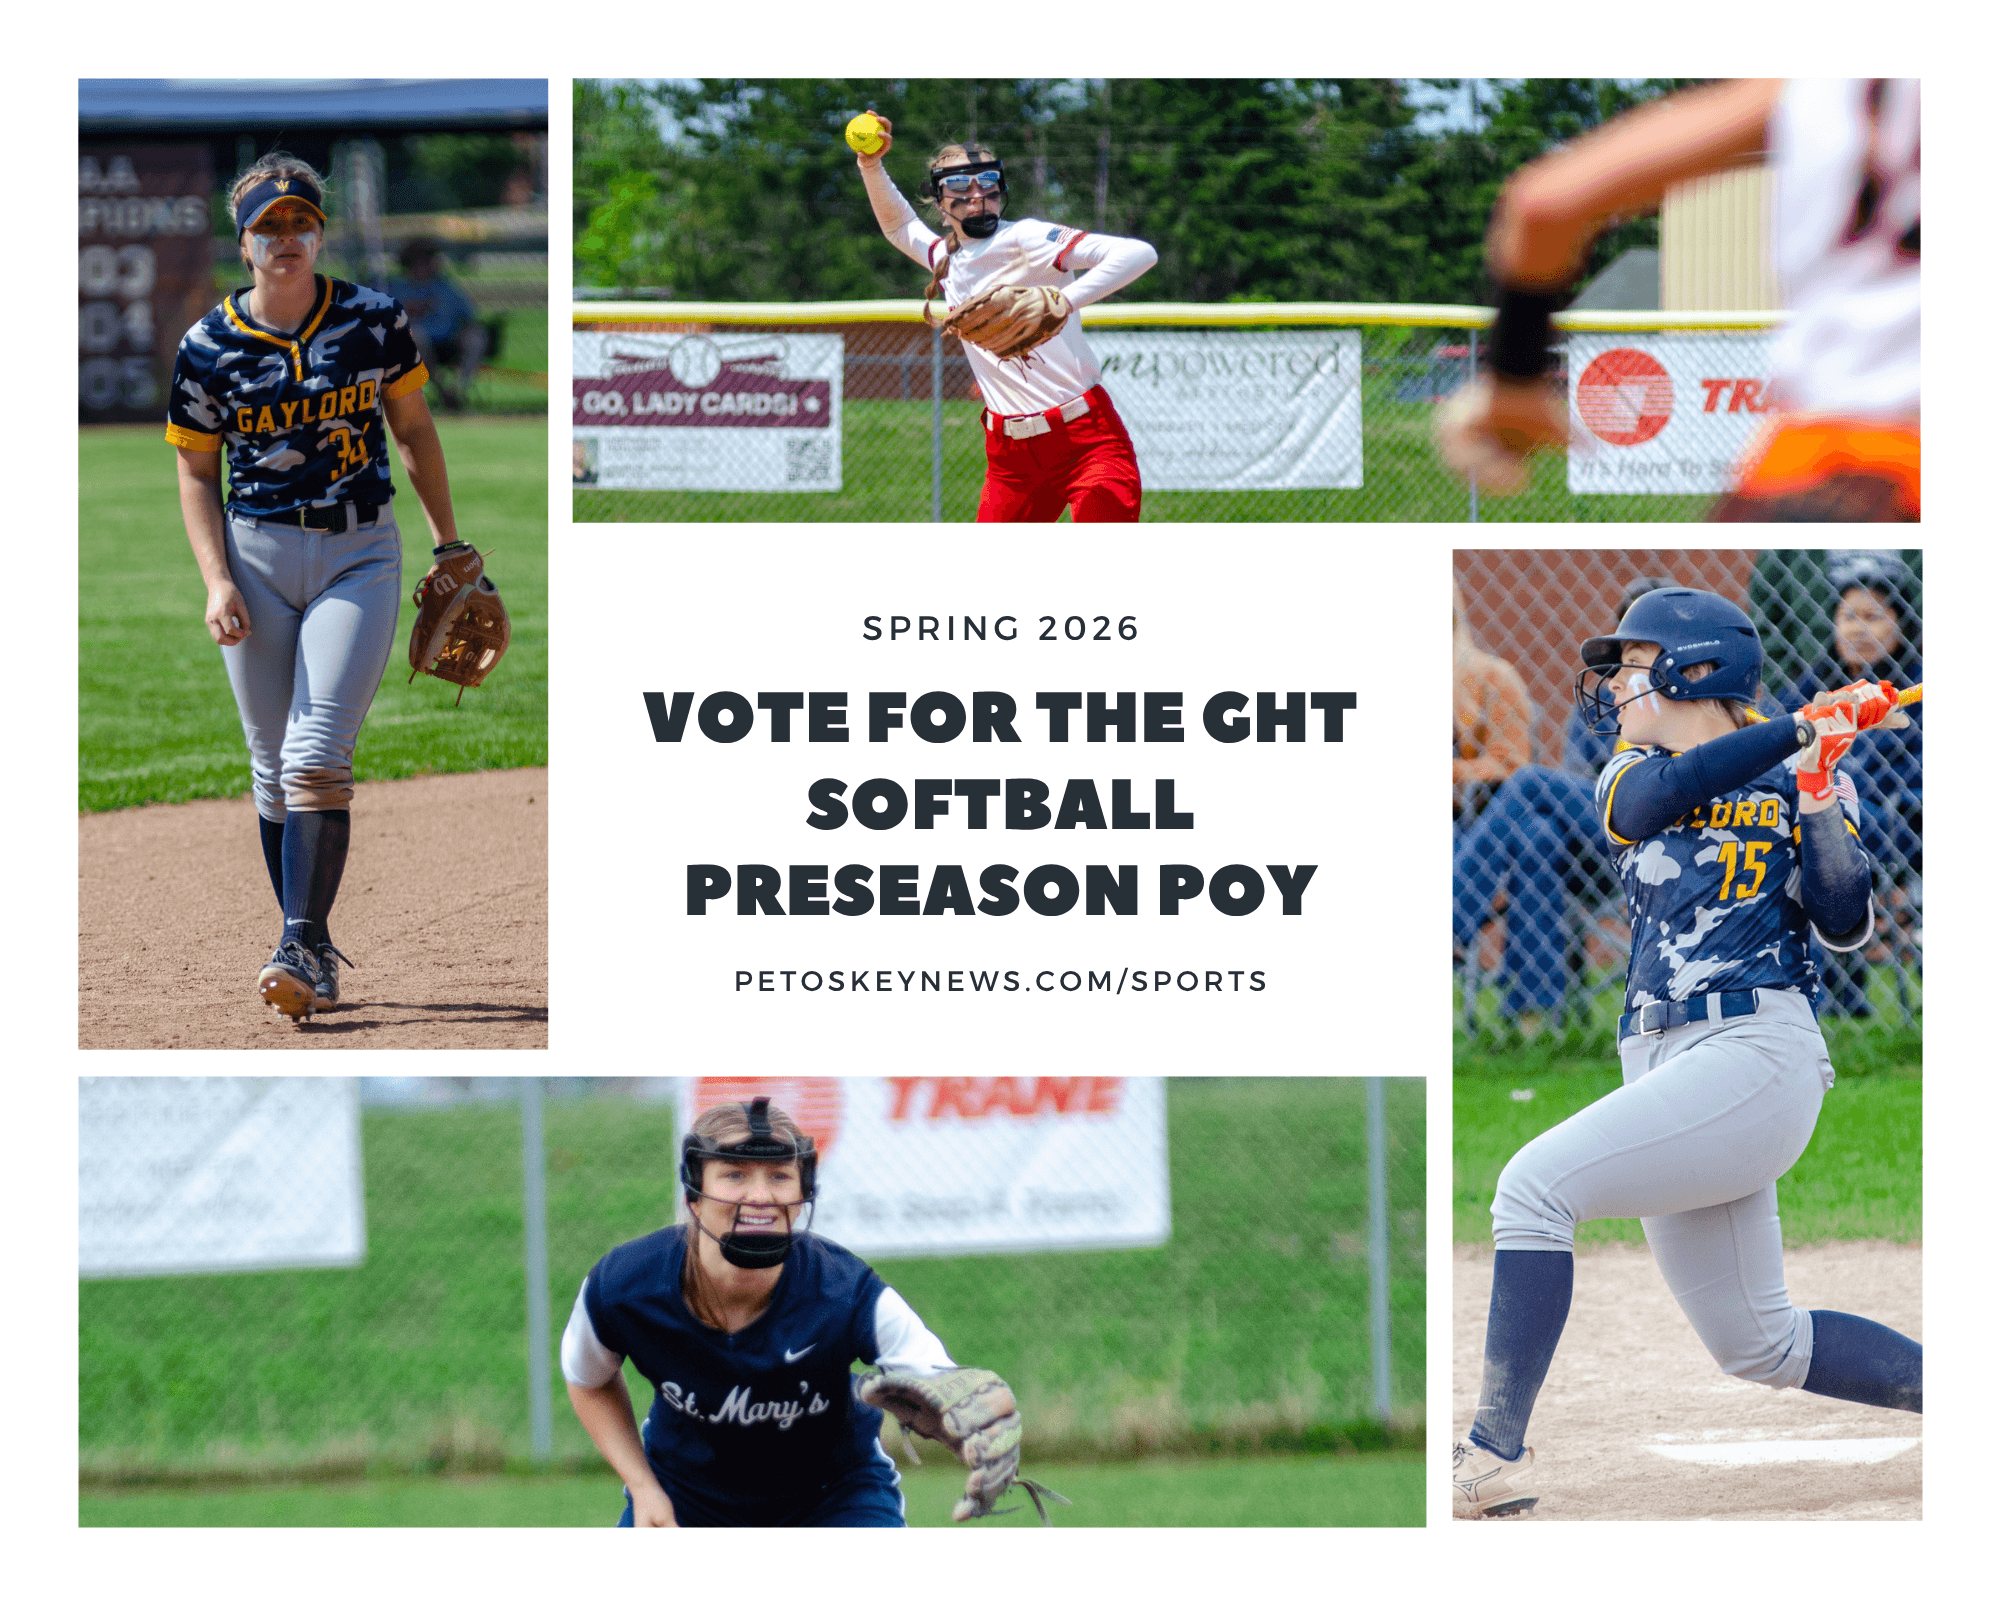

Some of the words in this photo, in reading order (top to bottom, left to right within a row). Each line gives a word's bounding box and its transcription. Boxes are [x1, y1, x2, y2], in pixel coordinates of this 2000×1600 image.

[1100, 342, 1340, 387] mpowered
[237, 379, 376, 433] GAYLORD
[632, 391, 699, 416] LADY
[328, 421, 370, 482] 34
[1717, 841, 1773, 901] 15
[661, 1381, 704, 1420] St.
[709, 1380, 830, 1430] Mary's
